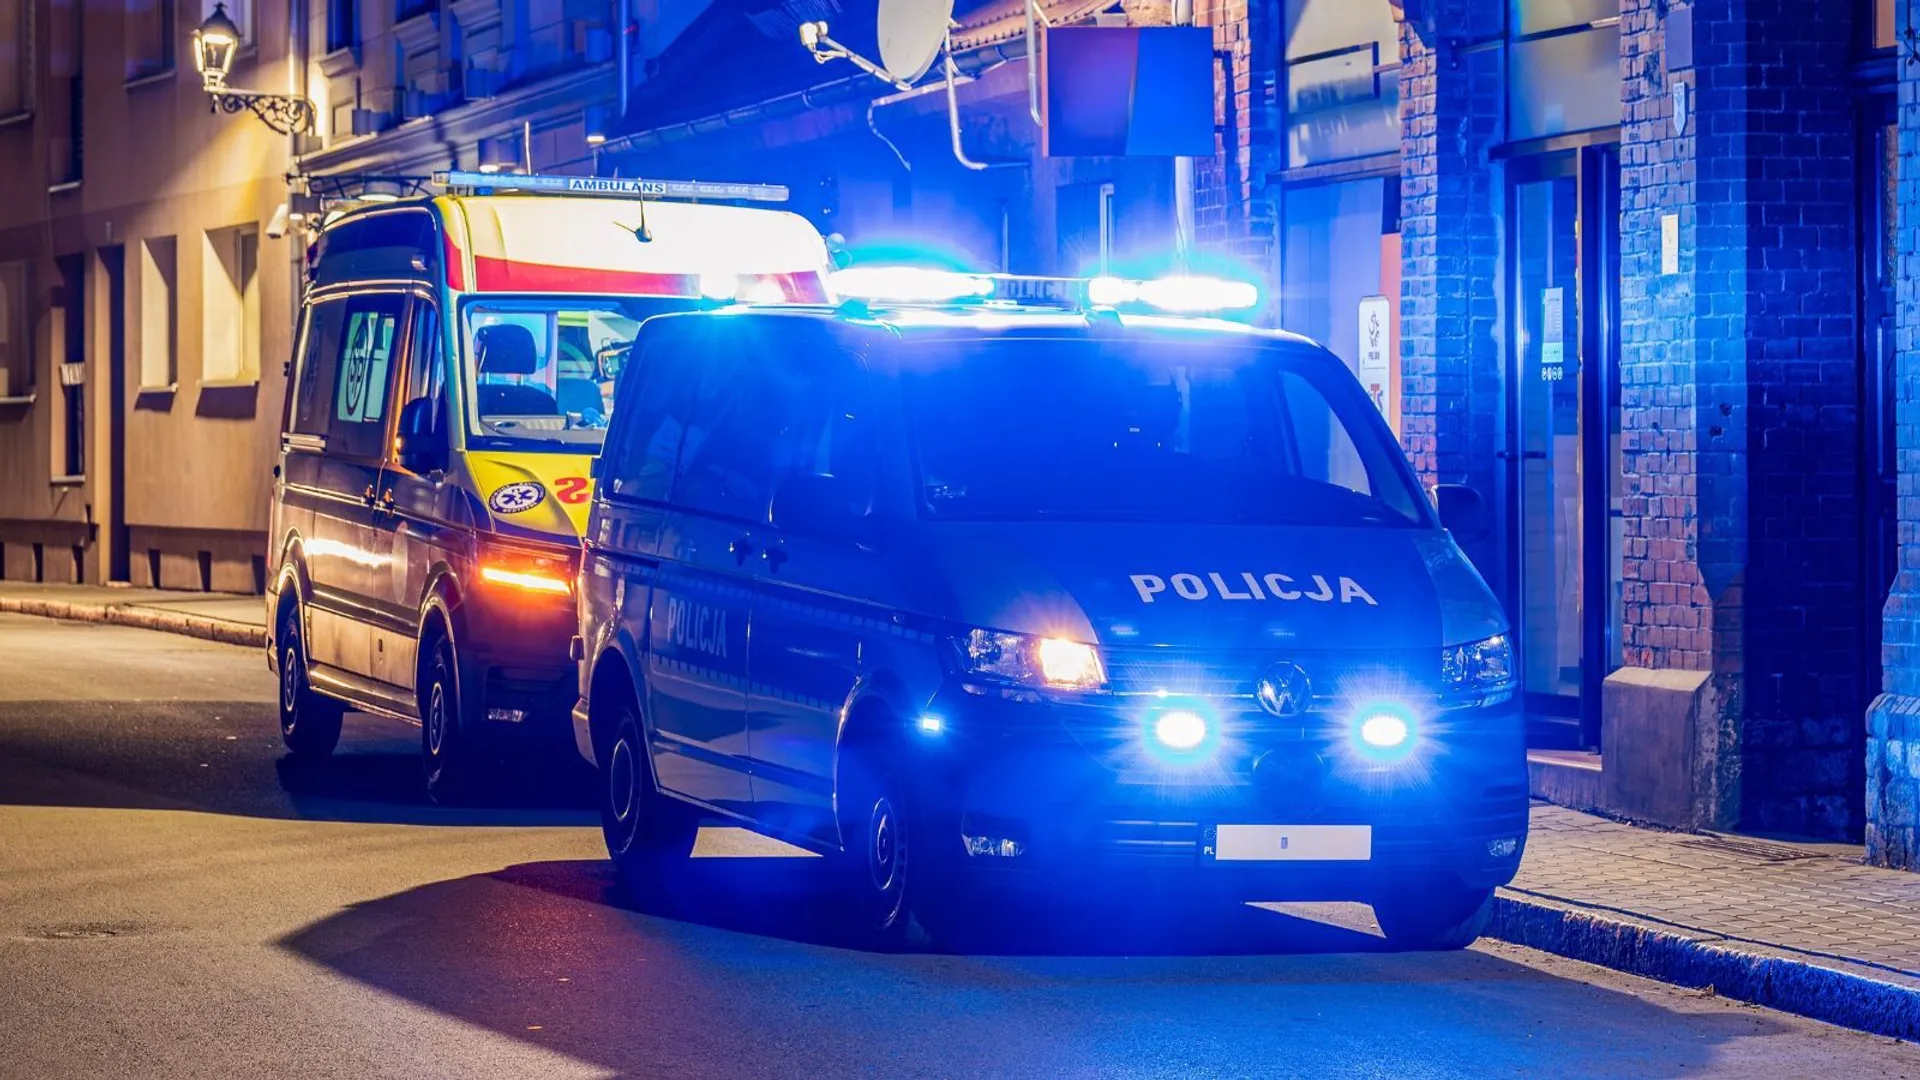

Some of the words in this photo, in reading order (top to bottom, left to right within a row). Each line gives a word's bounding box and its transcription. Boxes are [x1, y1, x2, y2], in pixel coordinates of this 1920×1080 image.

[572, 180, 664, 193] AMBULANS
[1129, 572, 1379, 605] POLICJA
[667, 596, 727, 658] POLICJA
[1203, 846, 1215, 855] PL
